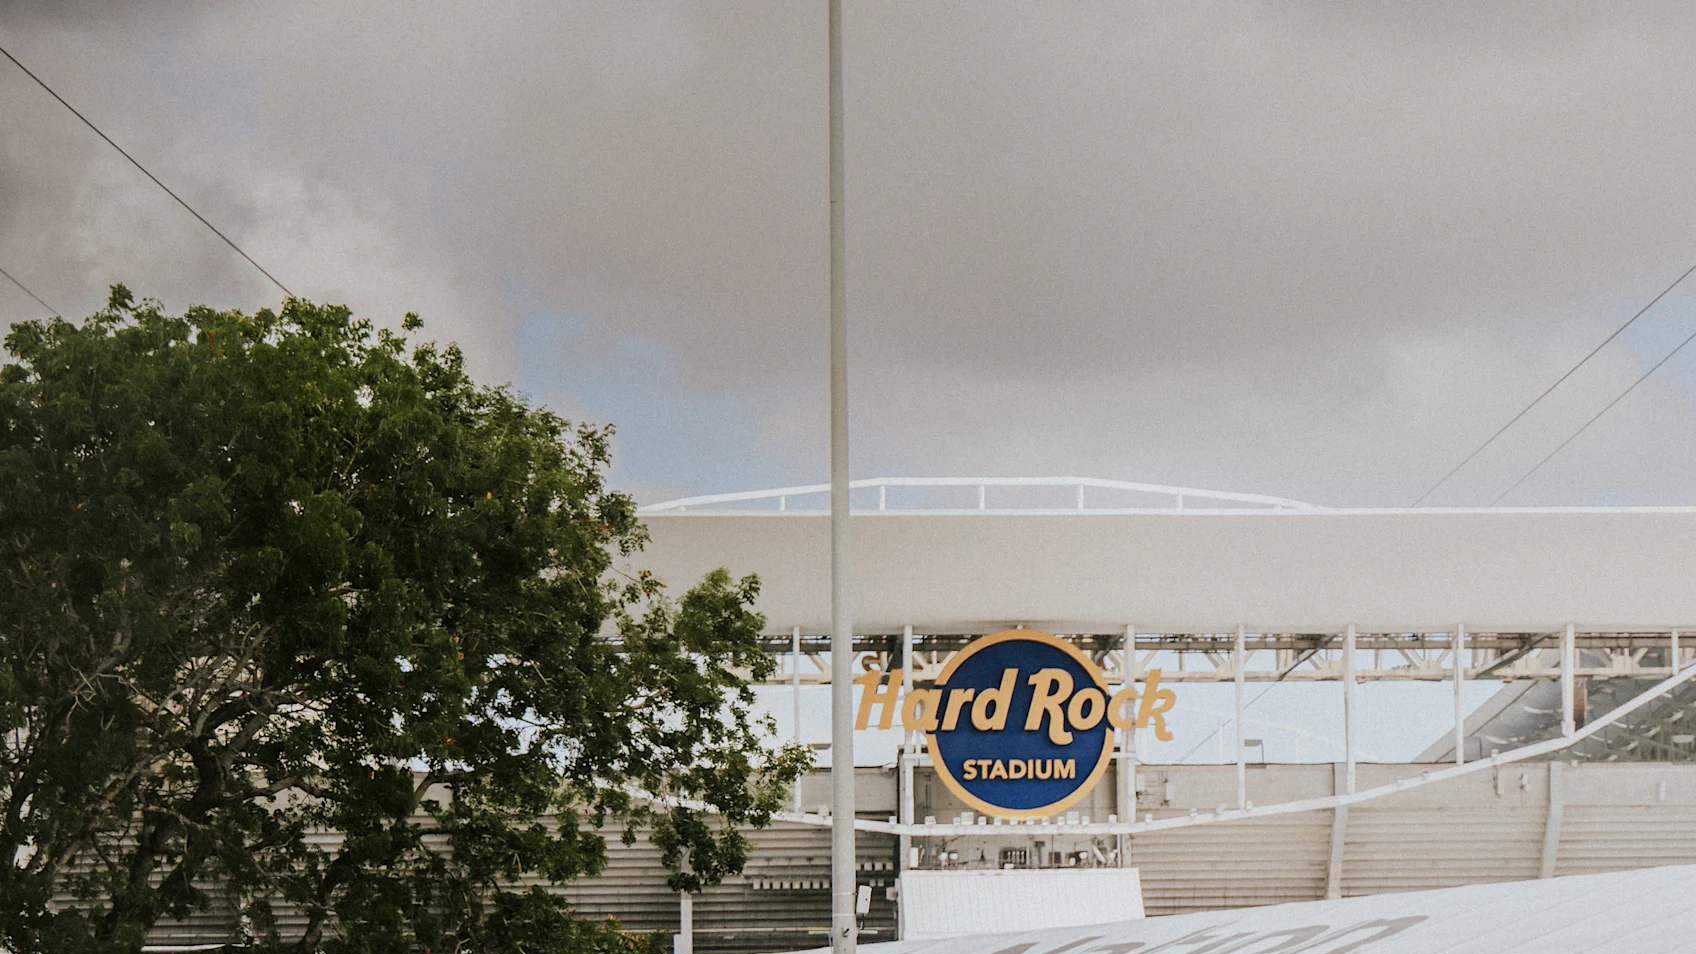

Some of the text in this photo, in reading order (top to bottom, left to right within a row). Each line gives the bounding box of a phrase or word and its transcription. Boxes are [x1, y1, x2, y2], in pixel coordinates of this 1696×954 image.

[854, 653, 1177, 745] Hard Rock
[962, 758, 1076, 781] STADIUM
